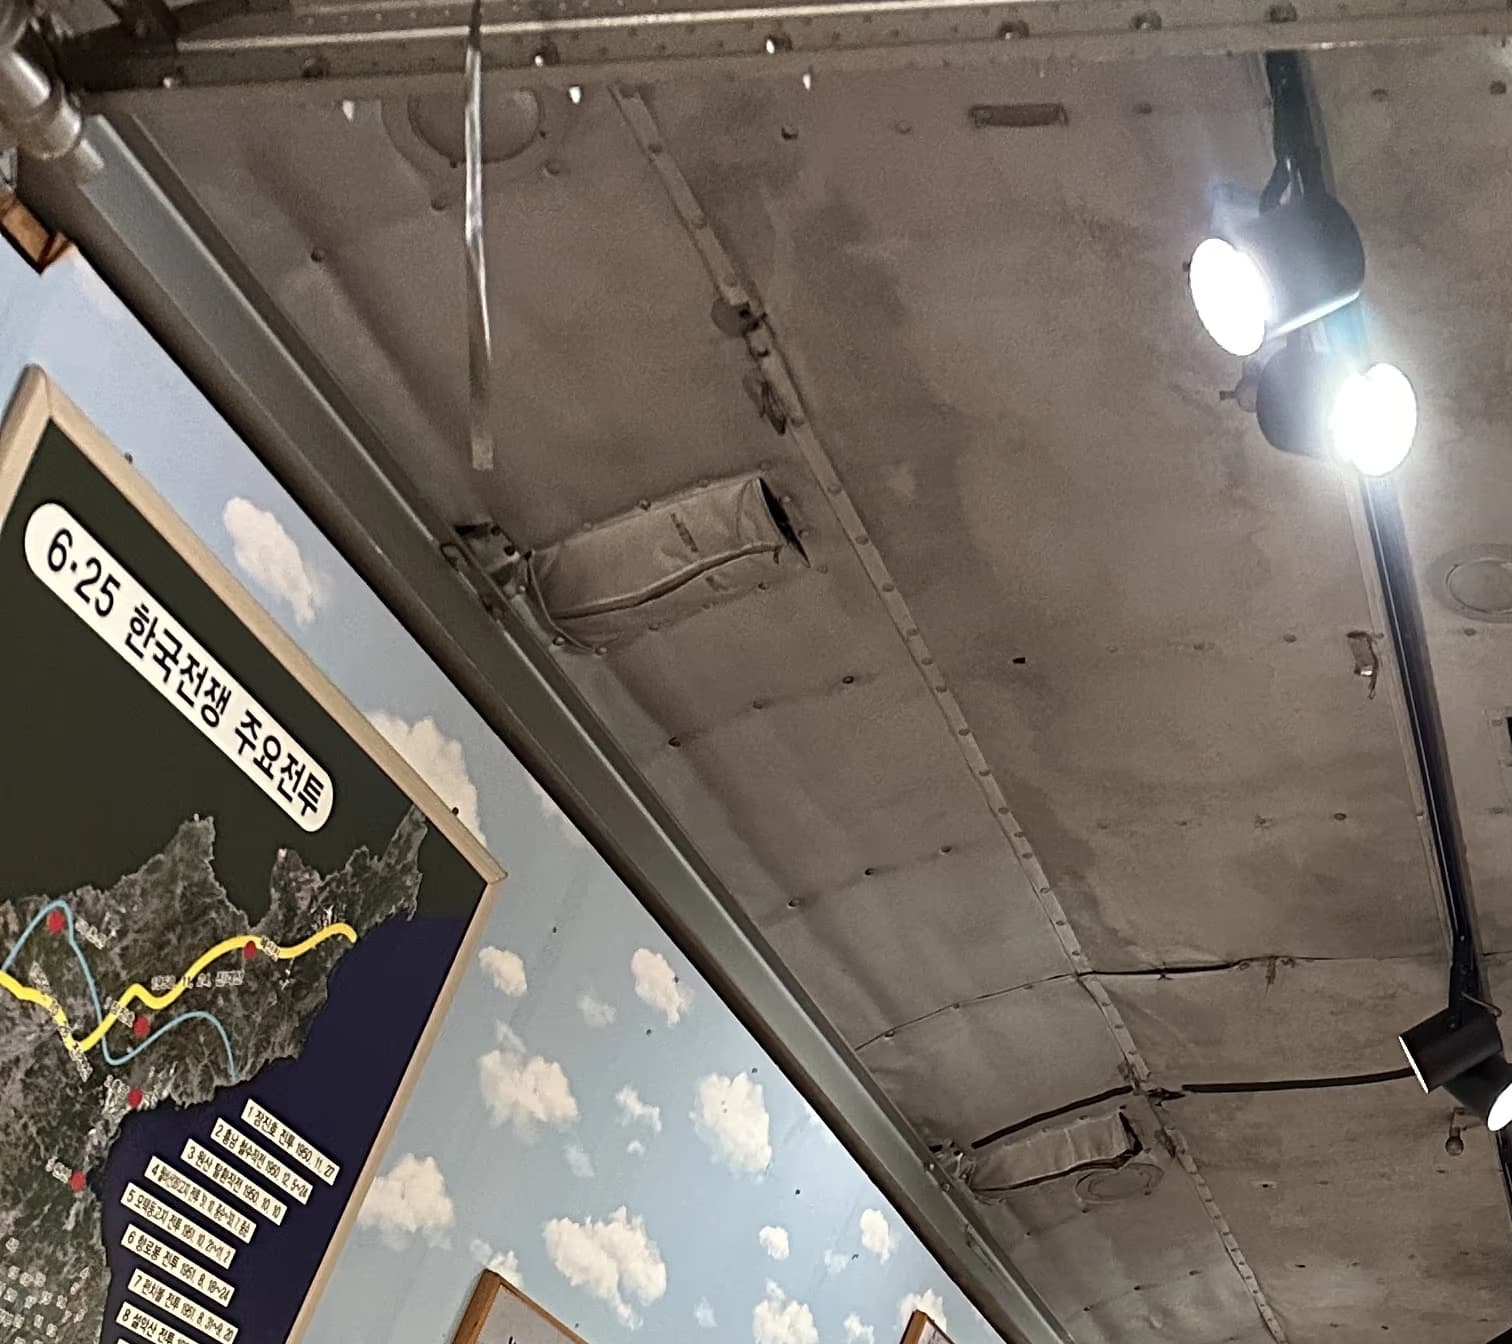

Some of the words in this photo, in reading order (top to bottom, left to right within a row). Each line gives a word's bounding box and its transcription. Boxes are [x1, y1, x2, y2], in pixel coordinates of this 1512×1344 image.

[47, 528, 118, 618] 6·25
[125, 603, 232, 727] 한국전쟁
[234, 709, 324, 816] 주요전투
[213, 1122, 224, 1139] 2
[221, 1126, 240, 1150] 흥남
[245, 1104, 254, 1119] 1
[251, 1108, 280, 1139] 장진호
[276, 1126, 296, 1151] 전투
[149, 1162, 160, 1178] 4
[185, 1144, 196, 1161] 3
[194, 1149, 214, 1174] 원산
[125, 1187, 136, 1204] 5
[165, 1212, 183, 1234] 전투
[125, 1229, 136, 1246] 6
[134, 1233, 163, 1262] 향로봉
[159, 1248, 180, 1272] 전투
[132, 1273, 143, 1290] 7
[163, 1290, 181, 1313] 전투
[121, 1307, 132, 1323] 8
[129, 1310, 158, 1339] 설악산
